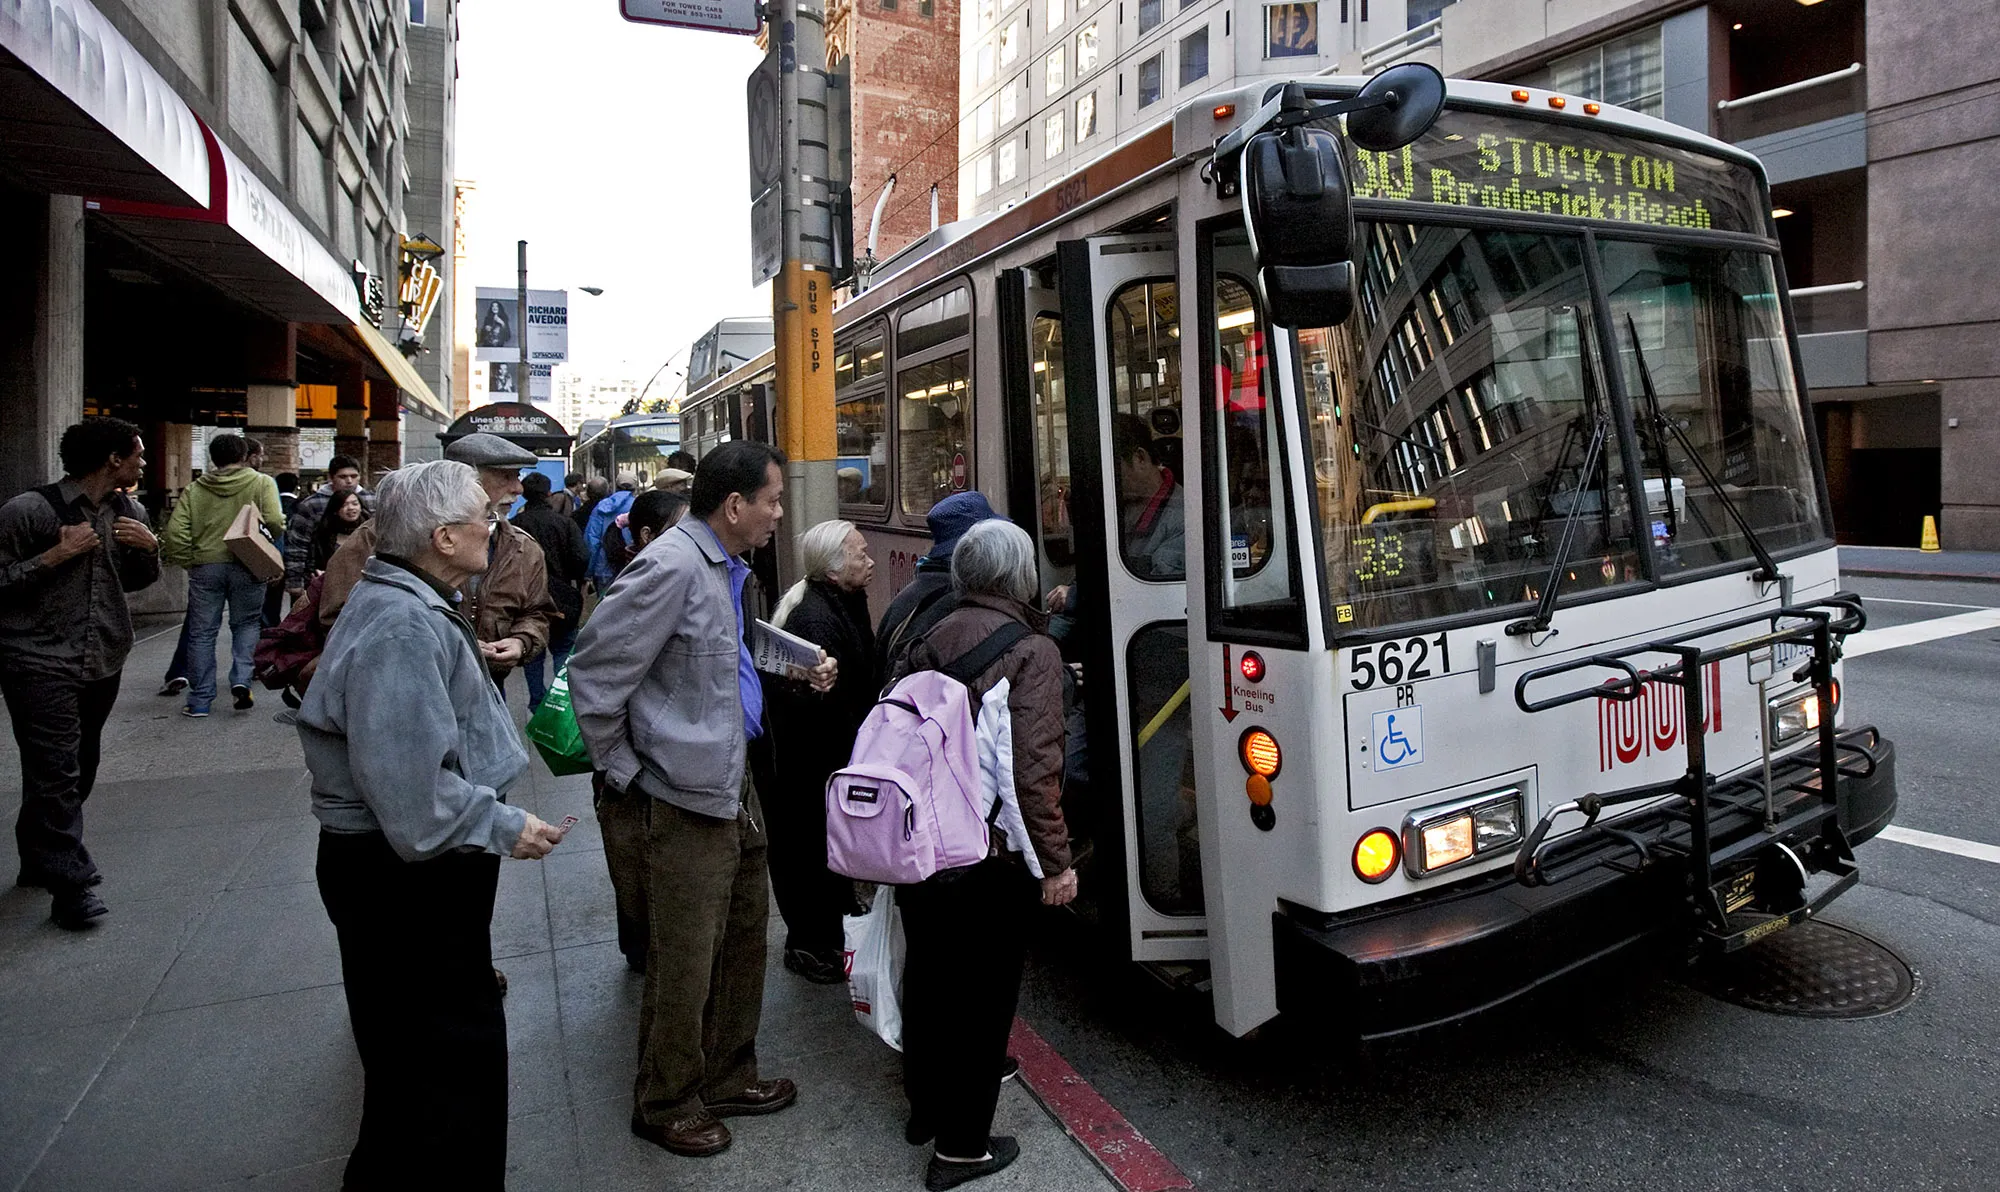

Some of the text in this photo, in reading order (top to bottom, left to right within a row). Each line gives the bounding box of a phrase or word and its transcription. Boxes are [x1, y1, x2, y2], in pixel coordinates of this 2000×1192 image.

[679, 3, 702, 11] TOWED
[1477, 132, 1675, 193] STOCKTON
[1056, 174, 1089, 213] 5621
[528, 305, 567, 315] RICHARD
[528, 314, 567, 325] AVEDON
[808, 280, 820, 372] BUS STOP
[530, 363, 552, 371] CHARD
[470, 416, 493, 424] Lines
[477, 424, 489, 432] 30
[1337, 607, 1352, 619] FB
[1350, 632, 1450, 690] 5621
[1233, 686, 1275, 703] Kneeling
[1396, 684, 1415, 708] PR
[1244, 700, 1264, 714] Bus
